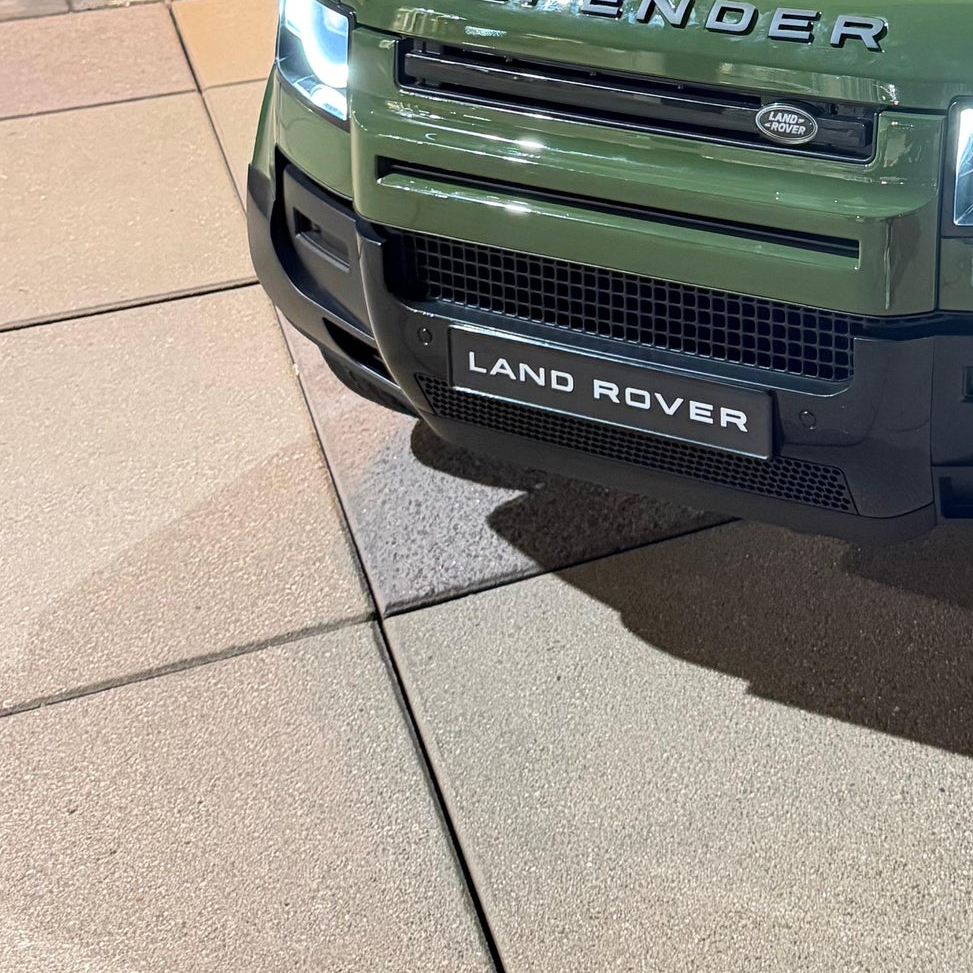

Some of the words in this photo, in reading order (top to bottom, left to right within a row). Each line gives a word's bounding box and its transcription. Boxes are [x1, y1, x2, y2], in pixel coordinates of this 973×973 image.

[768, 111, 798, 124] LAND
[770, 121, 806, 135] ROVER
[468, 351, 575, 393] LAND
[592, 378, 749, 433] ROVER
